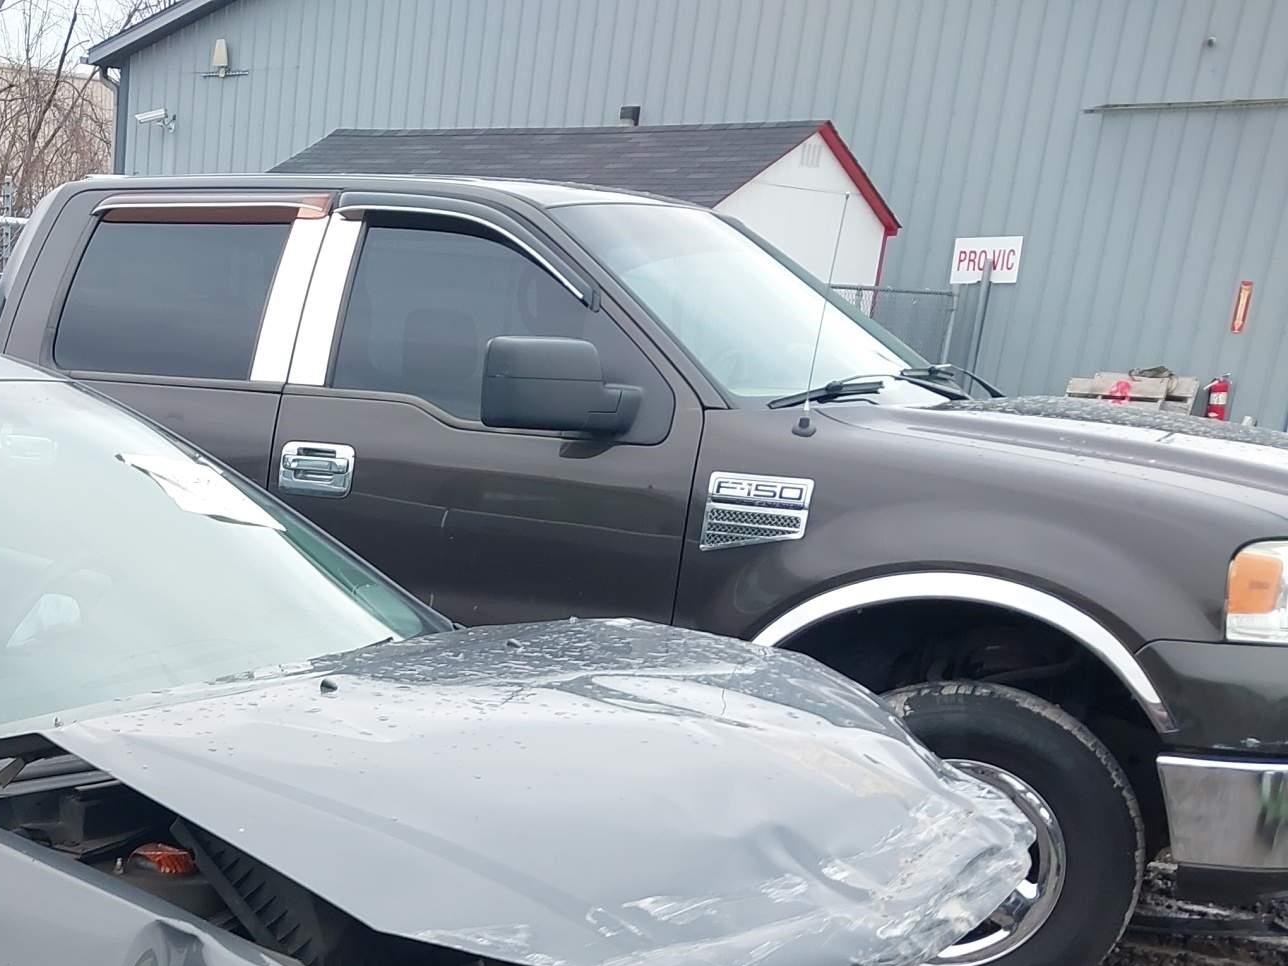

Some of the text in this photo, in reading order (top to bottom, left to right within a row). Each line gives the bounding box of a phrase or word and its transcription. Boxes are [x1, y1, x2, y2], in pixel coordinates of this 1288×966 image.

[957, 248, 1016, 272] PRO VIC
[715, 480, 804, 501] F-150
